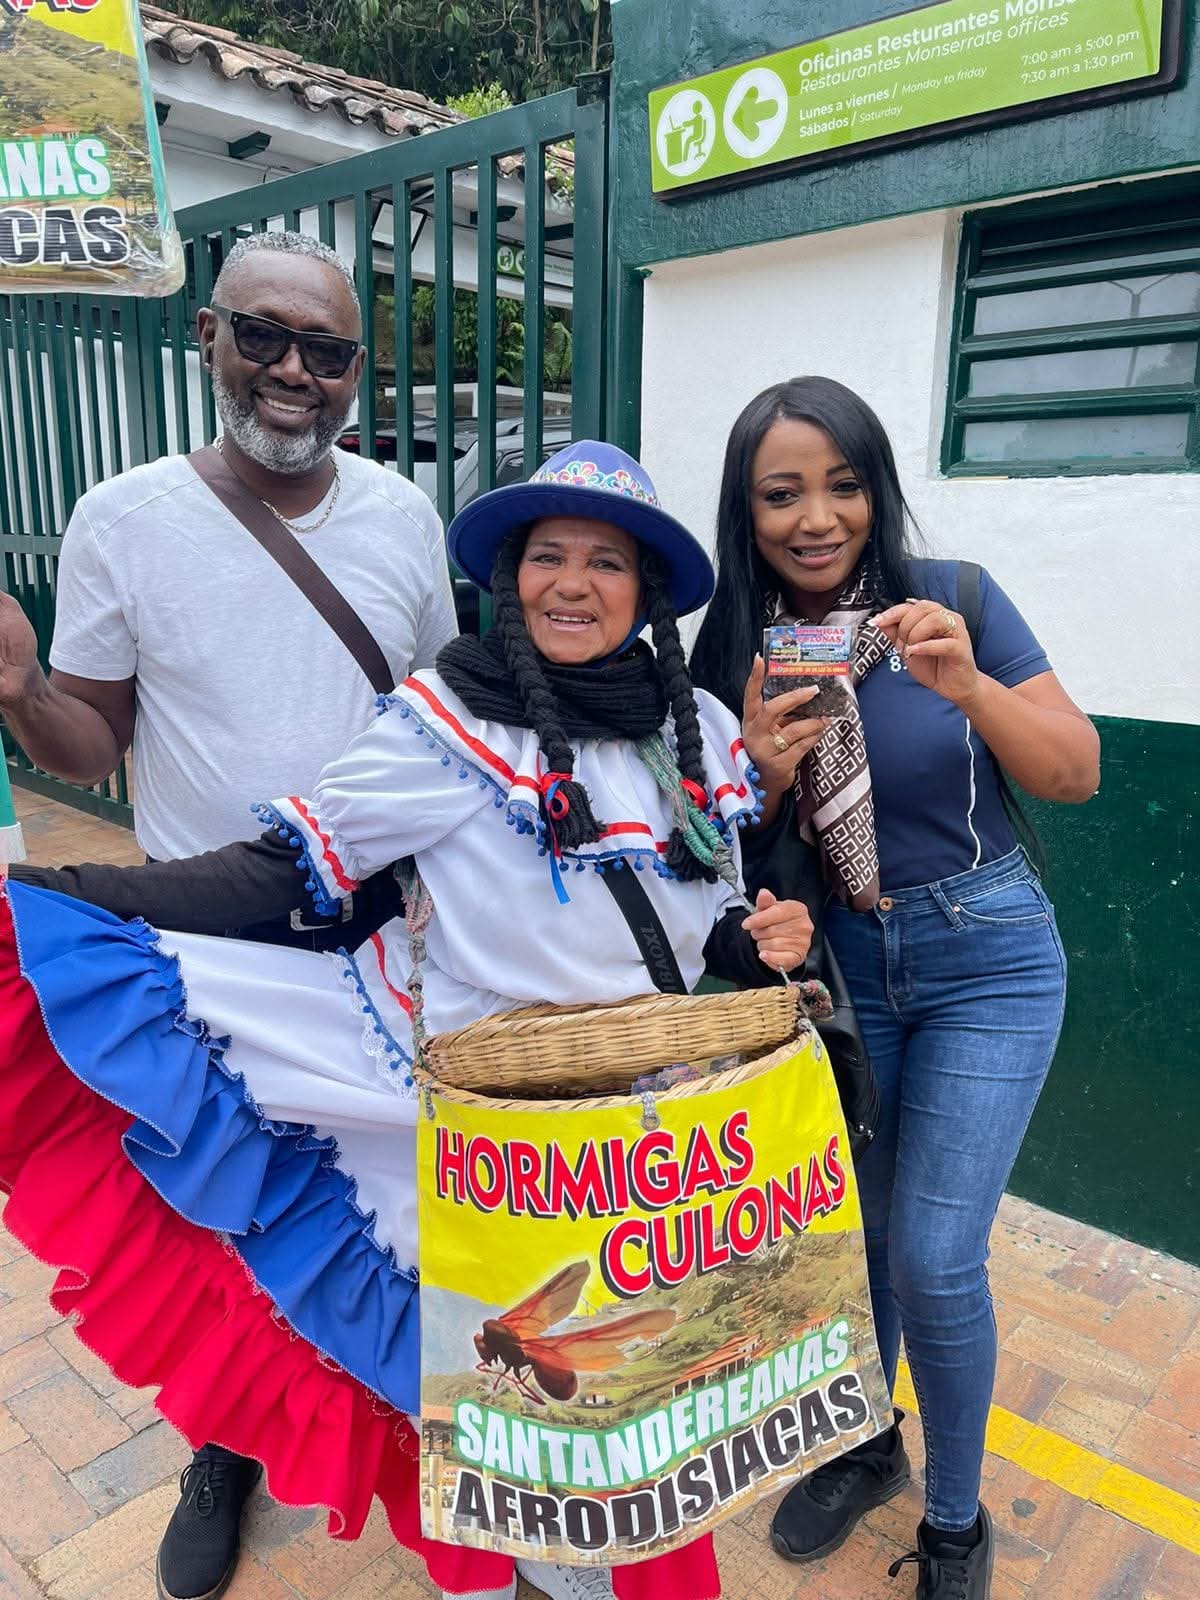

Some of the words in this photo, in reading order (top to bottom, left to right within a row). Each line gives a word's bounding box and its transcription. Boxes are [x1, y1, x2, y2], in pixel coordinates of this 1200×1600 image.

[799, 44, 872, 76] Oficinas
[877, 9, 1000, 55] Resturantes
[800, 56, 902, 94] Restaurantes
[905, 30, 1002, 64] Monserrate
[1008, 12, 1069, 38] offices
[1021, 50, 1048, 66] 7:00
[1051, 47, 1071, 60] am
[1074, 43, 1082, 54] a
[1086, 34, 1113, 51] 5:00
[1117, 30, 1140, 46] pm
[1021, 69, 1046, 84] 7:30
[1049, 66, 1069, 78] am
[1073, 63, 1080, 73] a
[1083, 55, 1107, 71] 1:30
[1111, 51, 1134, 66] pm
[800, 103, 833, 120] Lunes
[836, 101, 843, 111] a
[846, 88, 889, 109] viernes
[901, 79, 941, 94] Monday
[944, 74, 955, 84] to
[957, 67, 988, 82] friday
[800, 116, 849, 137] Sábados
[860, 105, 903, 122] Saturday
[436, 1111, 755, 1221] HORMIGAS
[600, 1135, 846, 1299] CULONAS
[457, 1320, 849, 1486] SANTANDEREANAS
[453, 1373, 869, 1551] AFRODISIACAS
